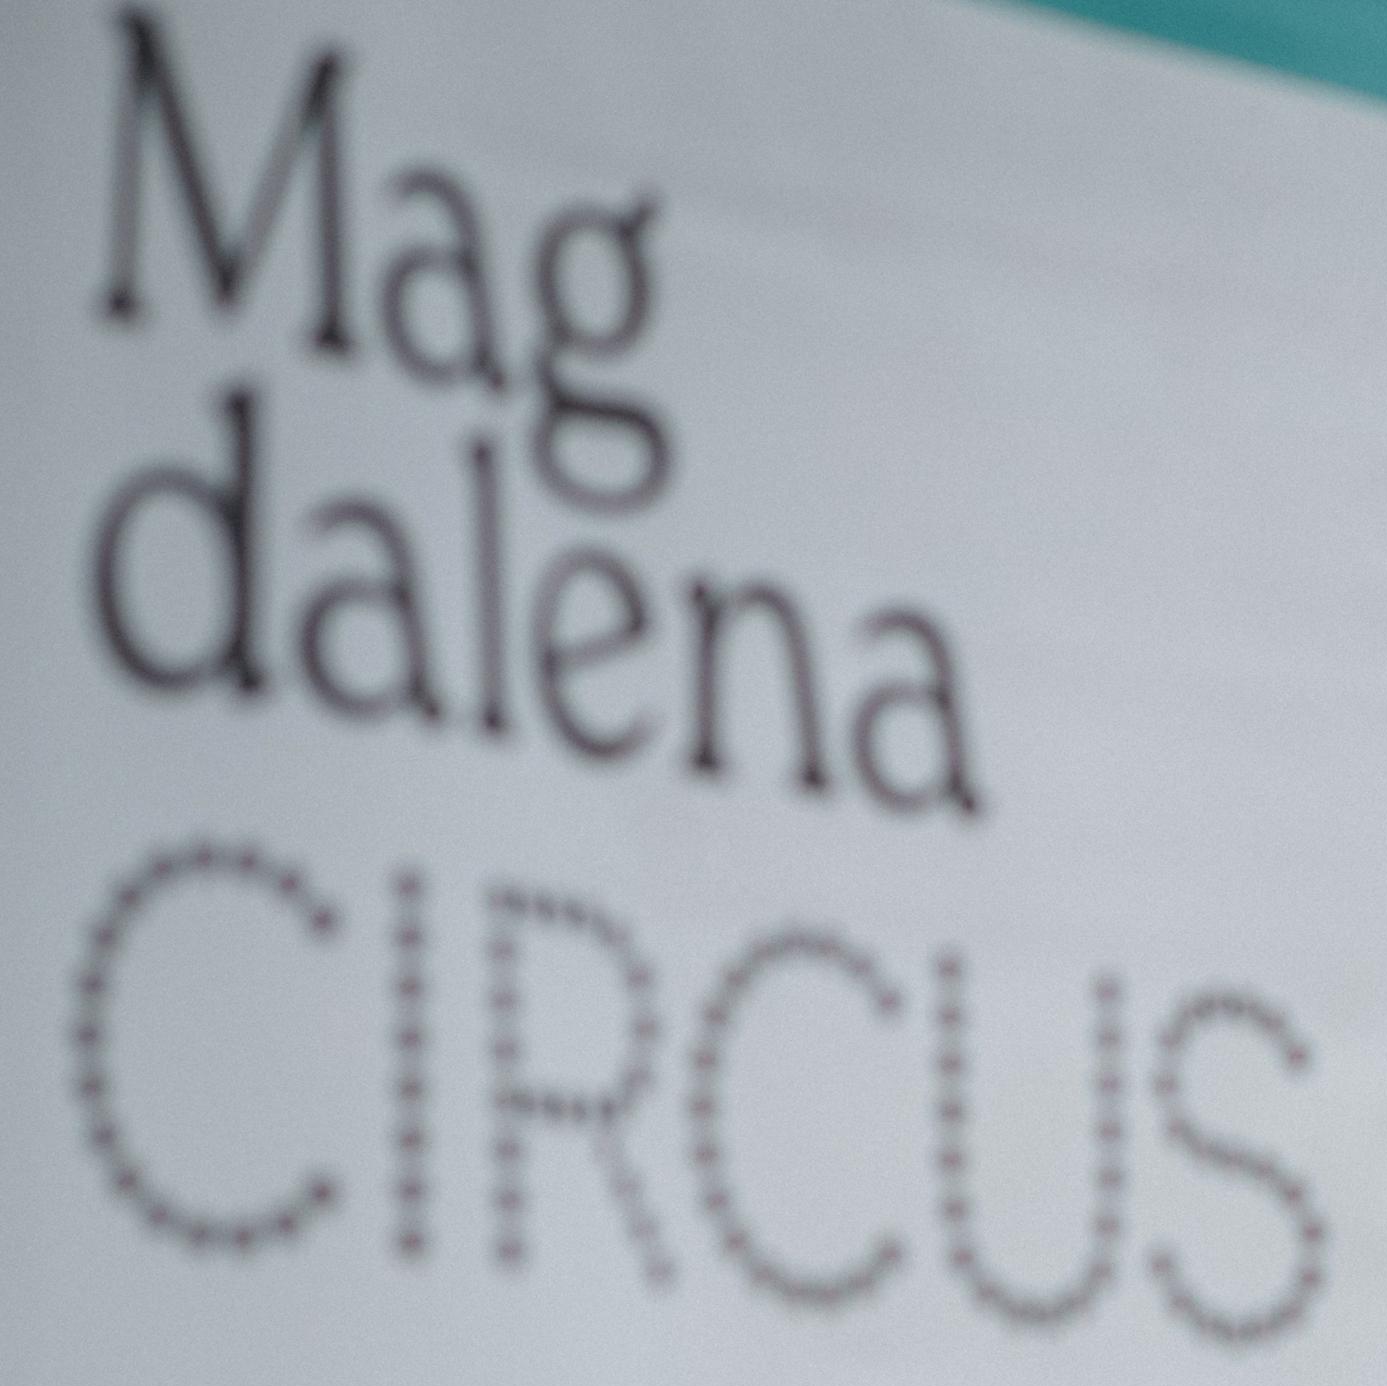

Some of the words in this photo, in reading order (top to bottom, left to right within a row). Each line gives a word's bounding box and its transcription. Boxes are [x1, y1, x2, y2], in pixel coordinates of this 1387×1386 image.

[94, 4, 673, 515] Mag
[90, 376, 984, 820] dalena
[70, 838, 1328, 1346] CIRCUS
